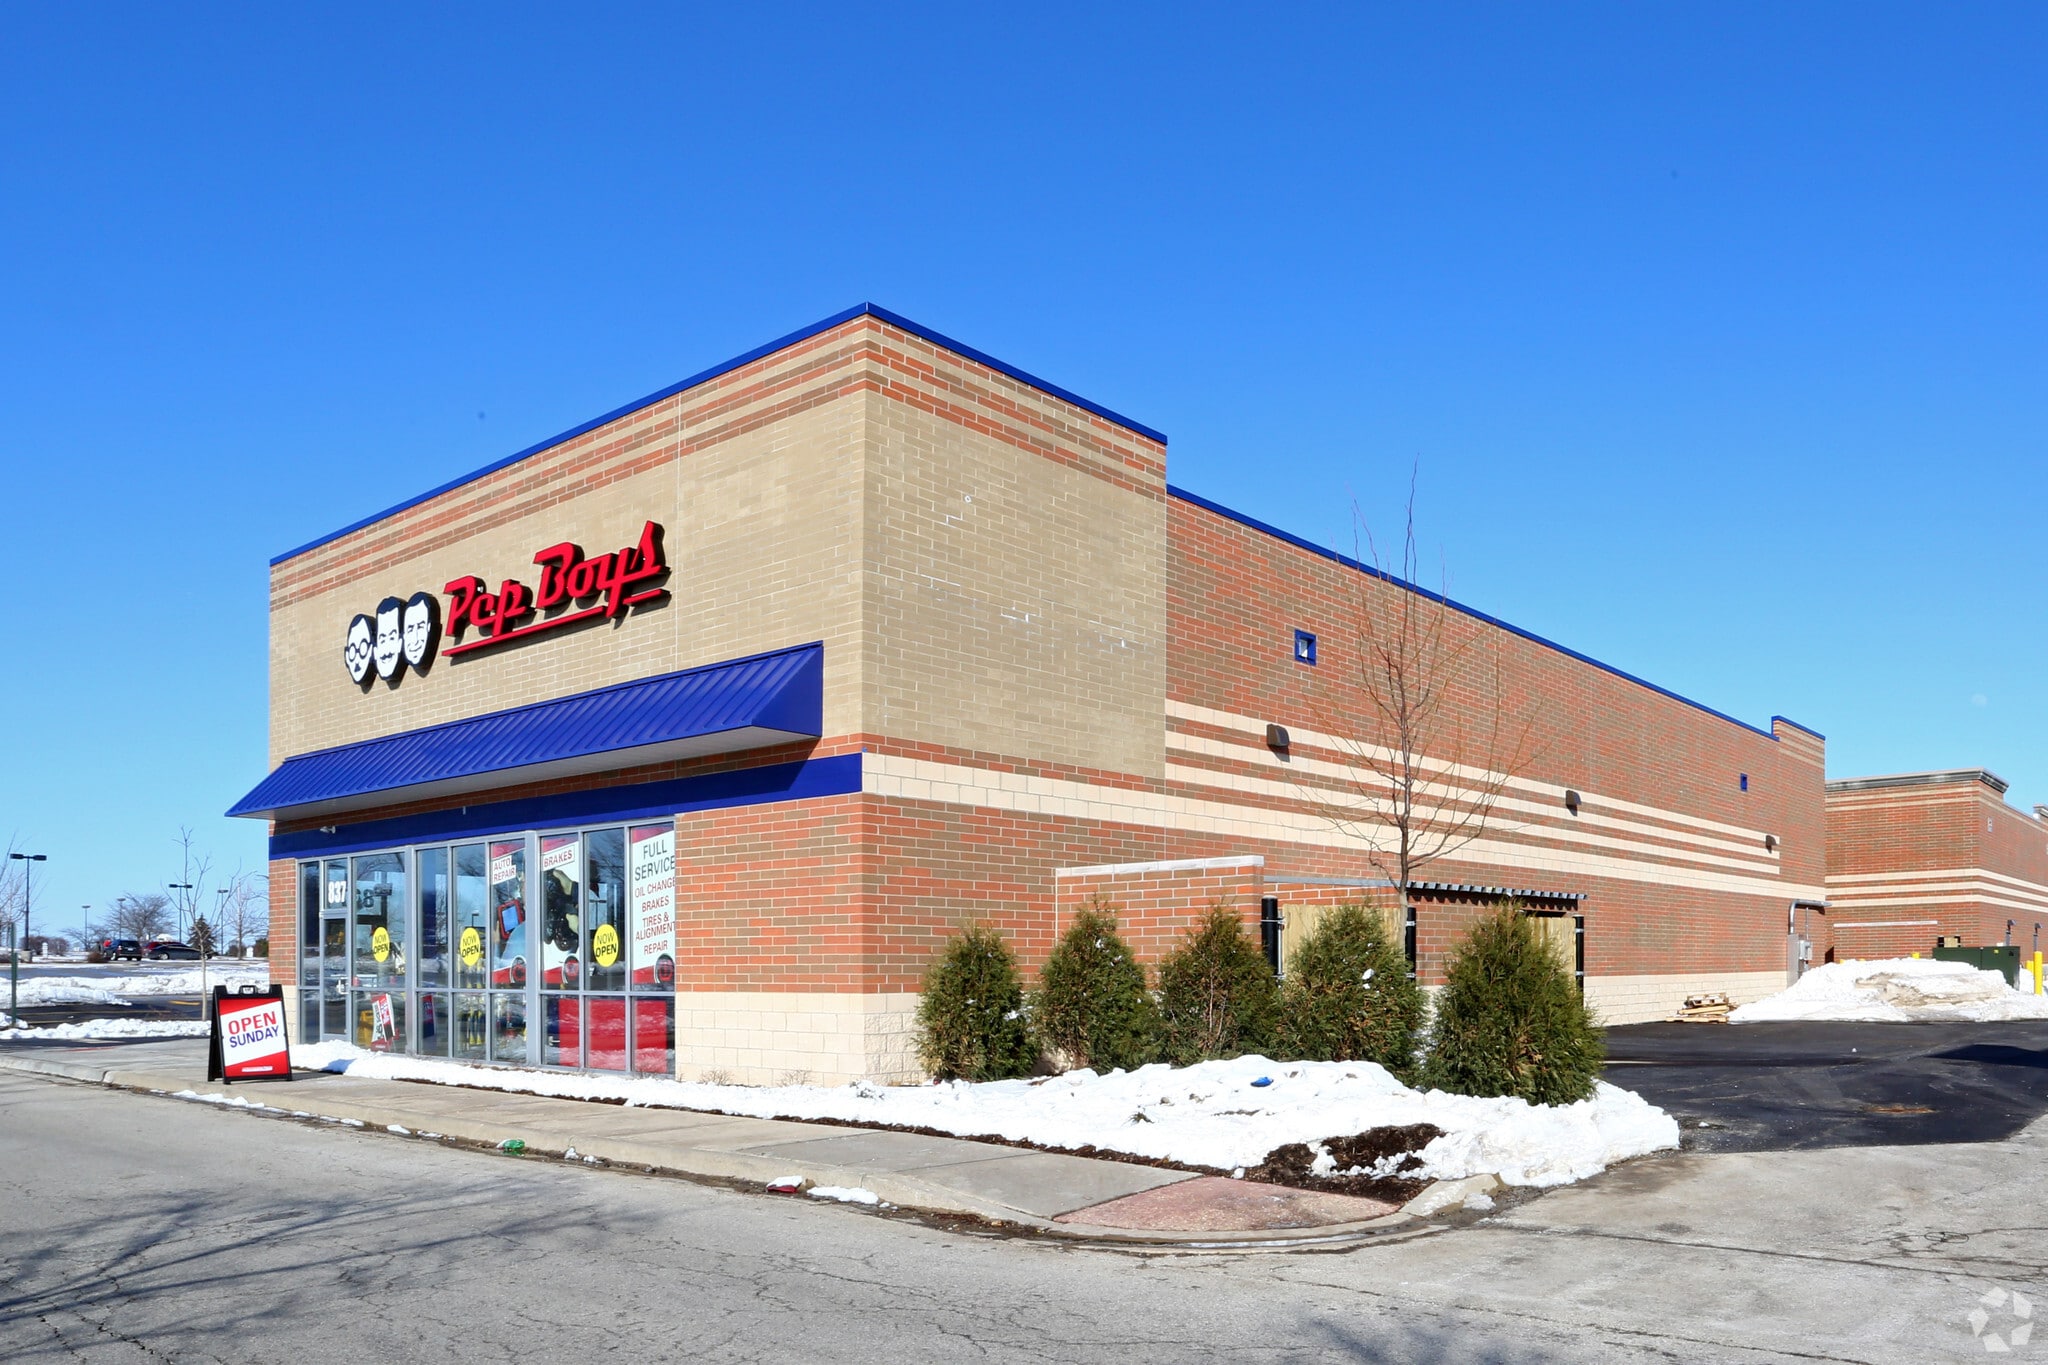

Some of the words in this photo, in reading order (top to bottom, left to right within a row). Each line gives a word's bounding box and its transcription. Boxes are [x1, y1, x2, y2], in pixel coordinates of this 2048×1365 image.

[443, 575, 526, 638] Pep
[533, 520, 662, 618] Boys
[643, 840, 668, 859] FULL
[493, 858, 511, 872] AUTO
[544, 850, 573, 867] BRAKES
[493, 868, 515, 882] REPAIR
[634, 855, 676, 882] SERVICE
[328, 880, 346, 904] 837
[634, 886, 645, 898] OIL
[647, 877, 676, 895] CHANGE
[642, 895, 670, 913] BRAKES
[642, 914, 662, 928] TIRES
[664, 912, 670, 922] &
[374, 933, 387, 944] NOW
[596, 931, 615, 944] NOW
[635, 921, 676, 942] ALIGNMENT
[462, 935, 477, 947] NOW
[643, 940, 668, 956] REPAIR
[374, 944, 389, 955] OPEN
[462, 946, 479, 958] OPEN
[595, 944, 617, 958] OPEN
[229, 1011, 277, 1035] OPEN
[230, 1025, 279, 1048] SUNDAY
